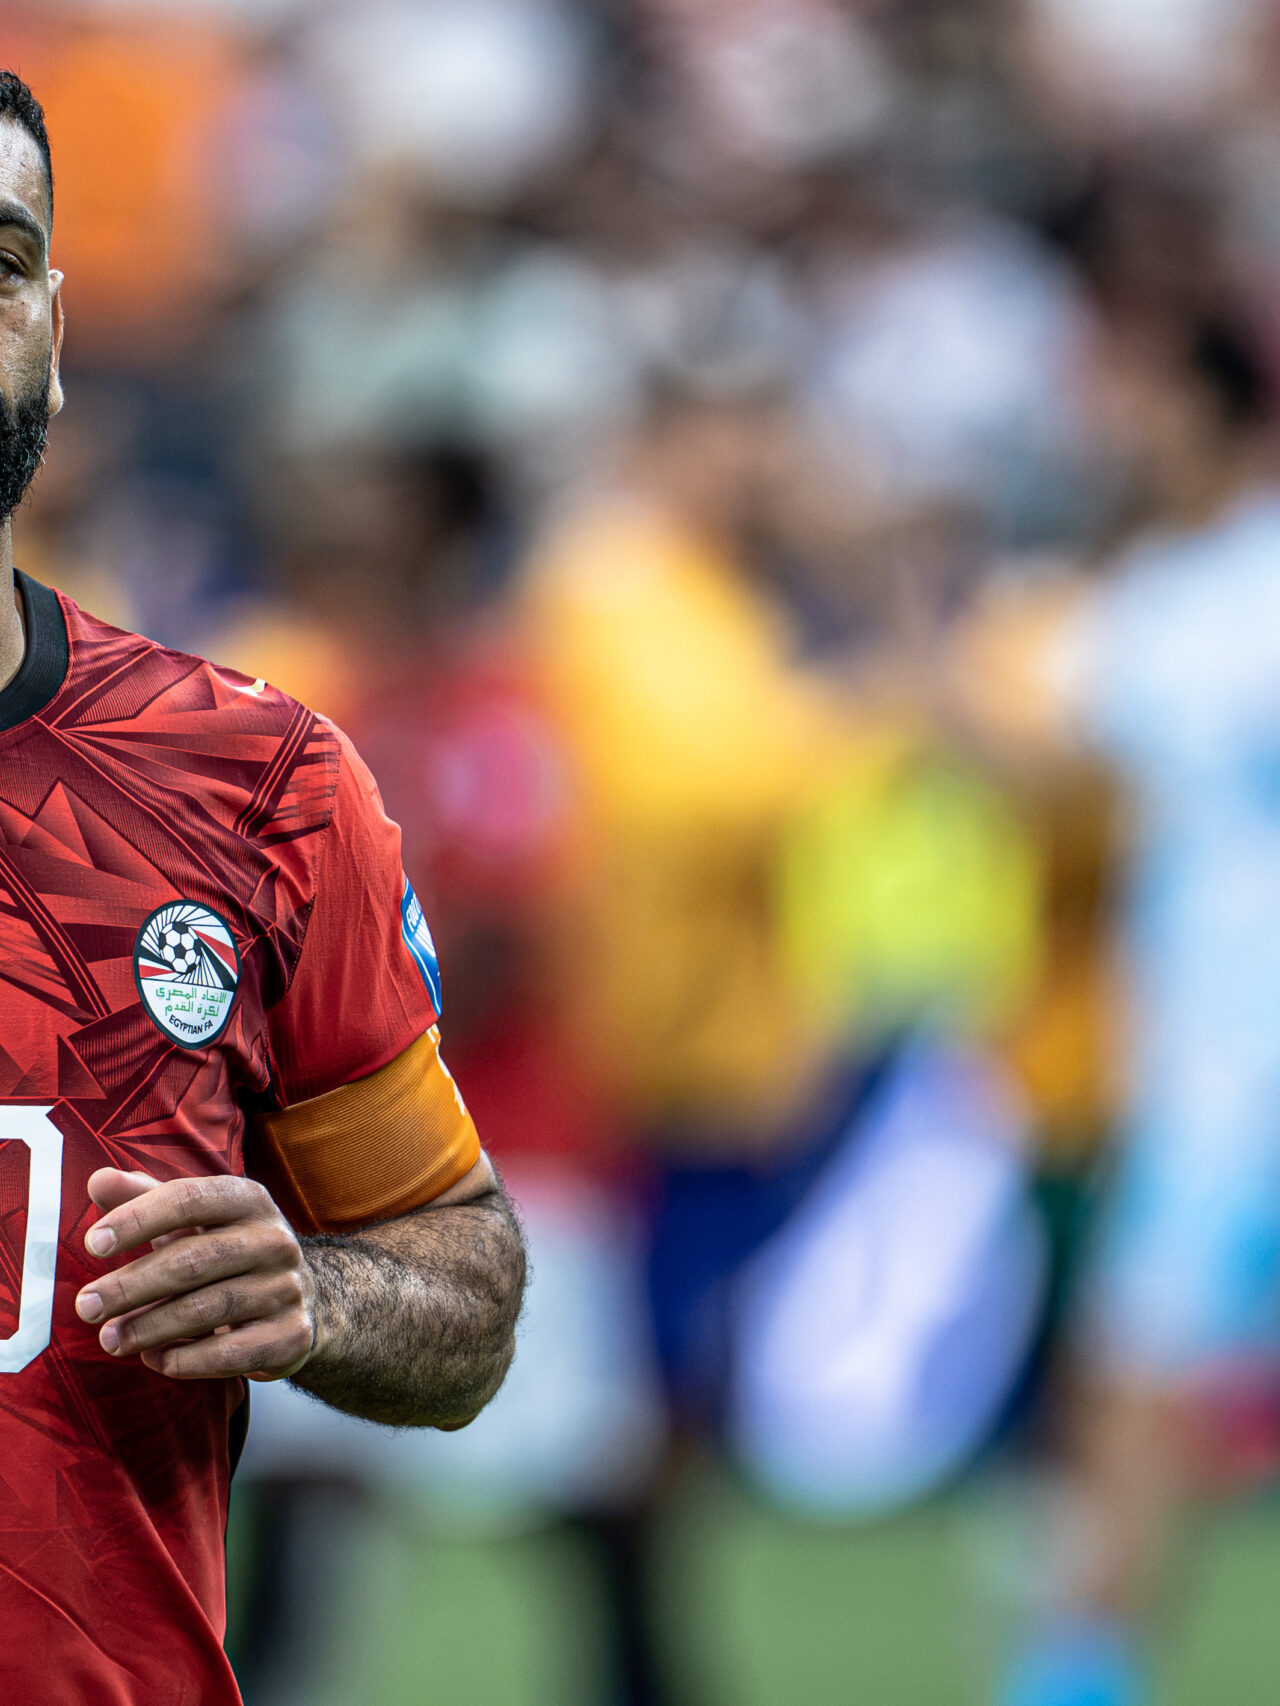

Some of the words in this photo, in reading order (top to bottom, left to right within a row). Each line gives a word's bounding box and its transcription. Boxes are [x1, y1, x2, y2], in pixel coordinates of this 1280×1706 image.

[156, 987, 197, 1001] المصري
[165, 1001, 194, 1017] القدم
[197, 1003, 220, 1020] لكرة
[169, 1014, 203, 1035] EGYPTIAN
[204, 1019, 213, 1032] FA
